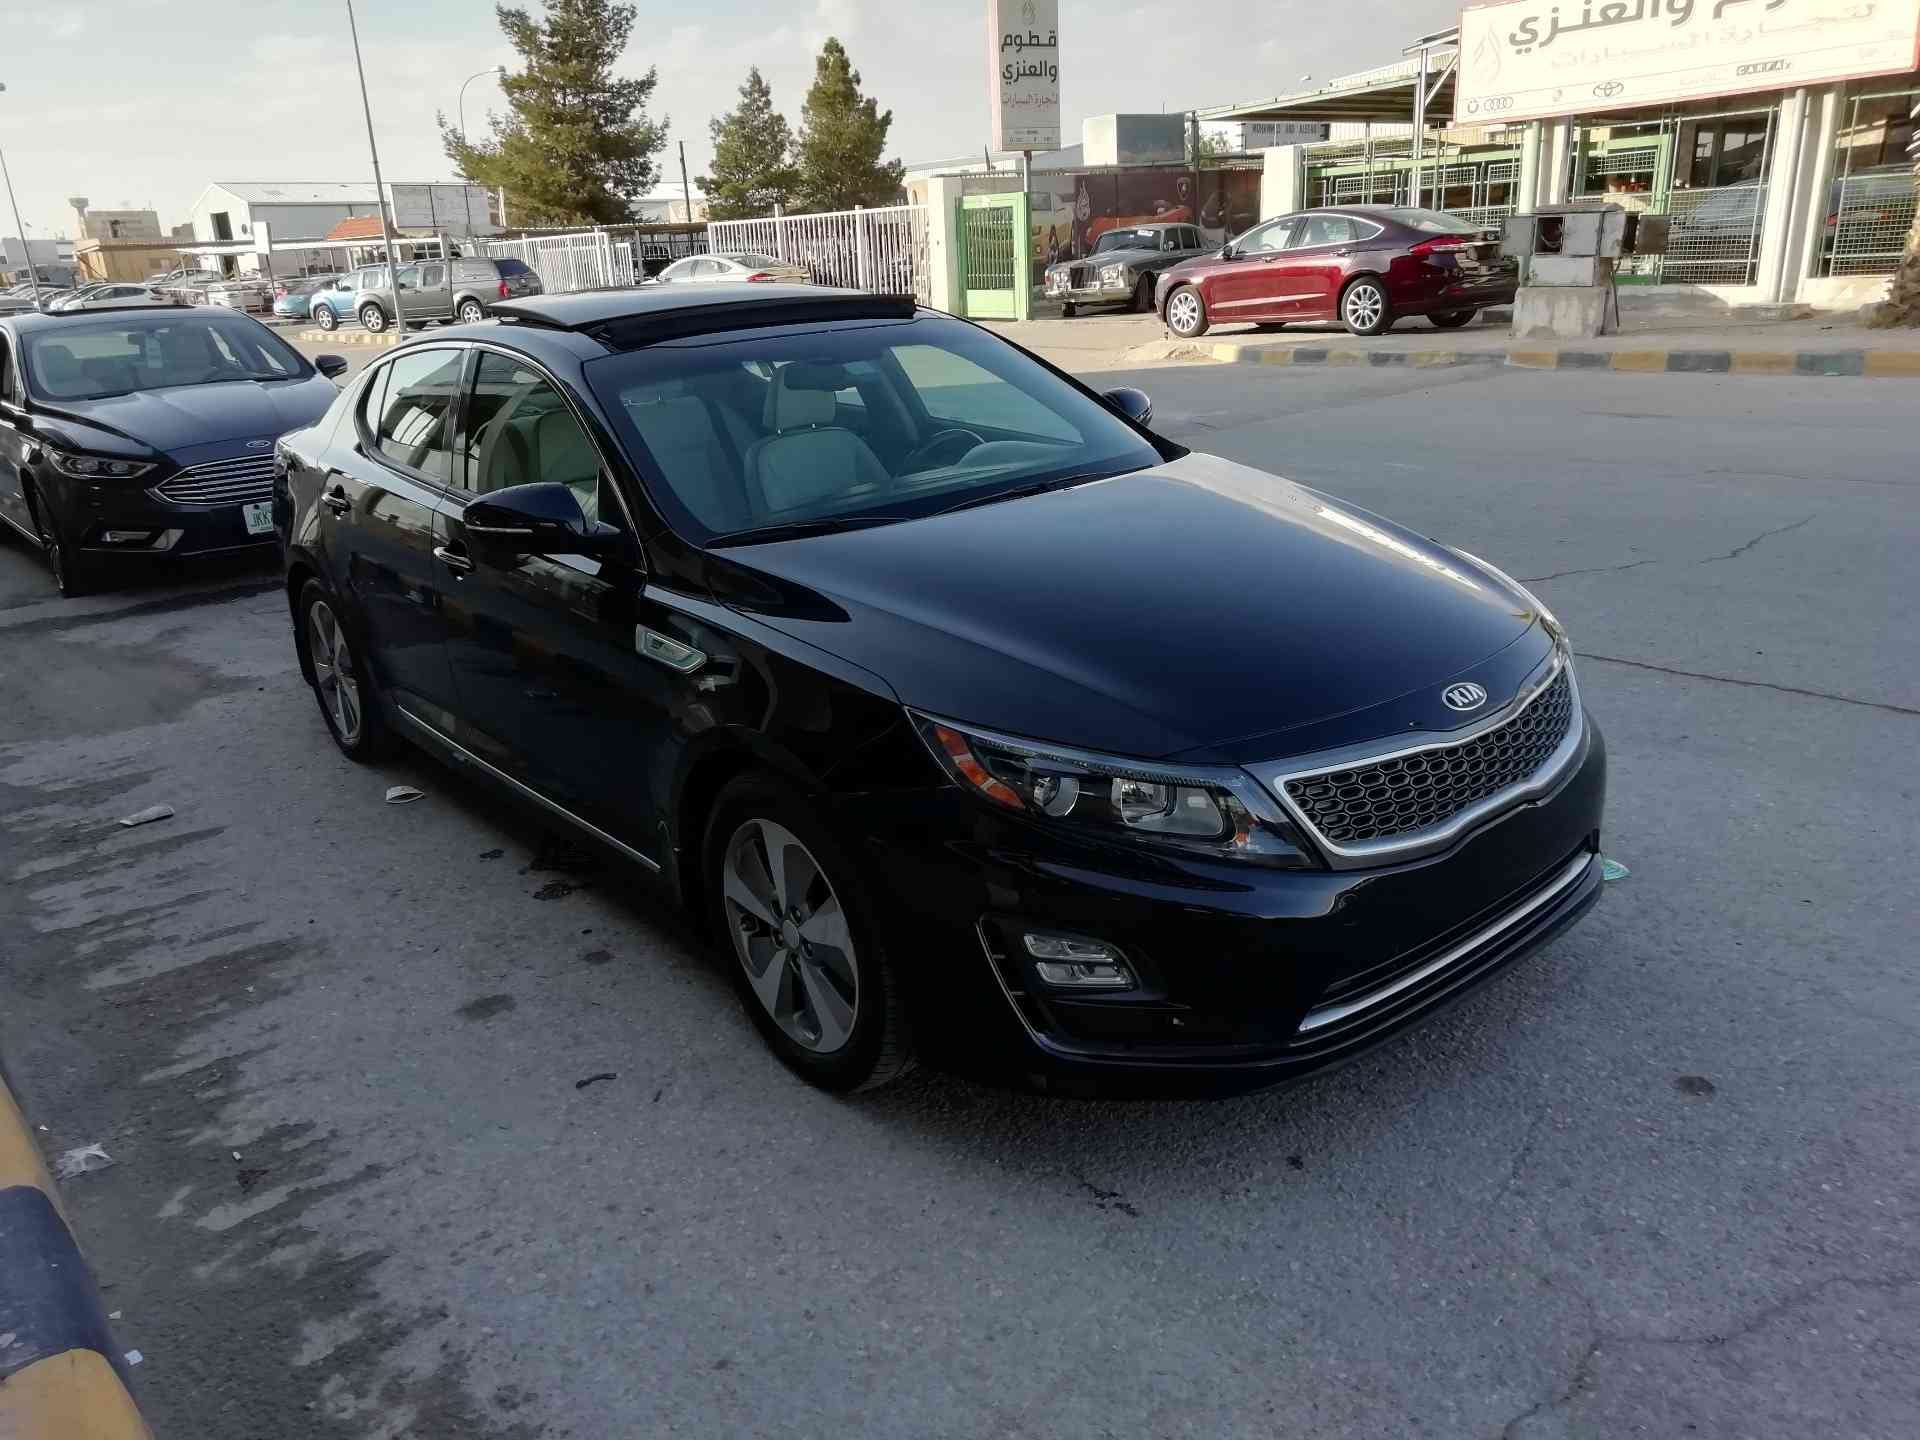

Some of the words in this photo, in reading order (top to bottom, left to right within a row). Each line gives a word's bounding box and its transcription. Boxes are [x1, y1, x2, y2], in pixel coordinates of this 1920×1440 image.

[1001, 30, 1057, 52] قطوم
[1002, 60, 1058, 85] والعنزي
[1446, 685, 1485, 707] KIA
